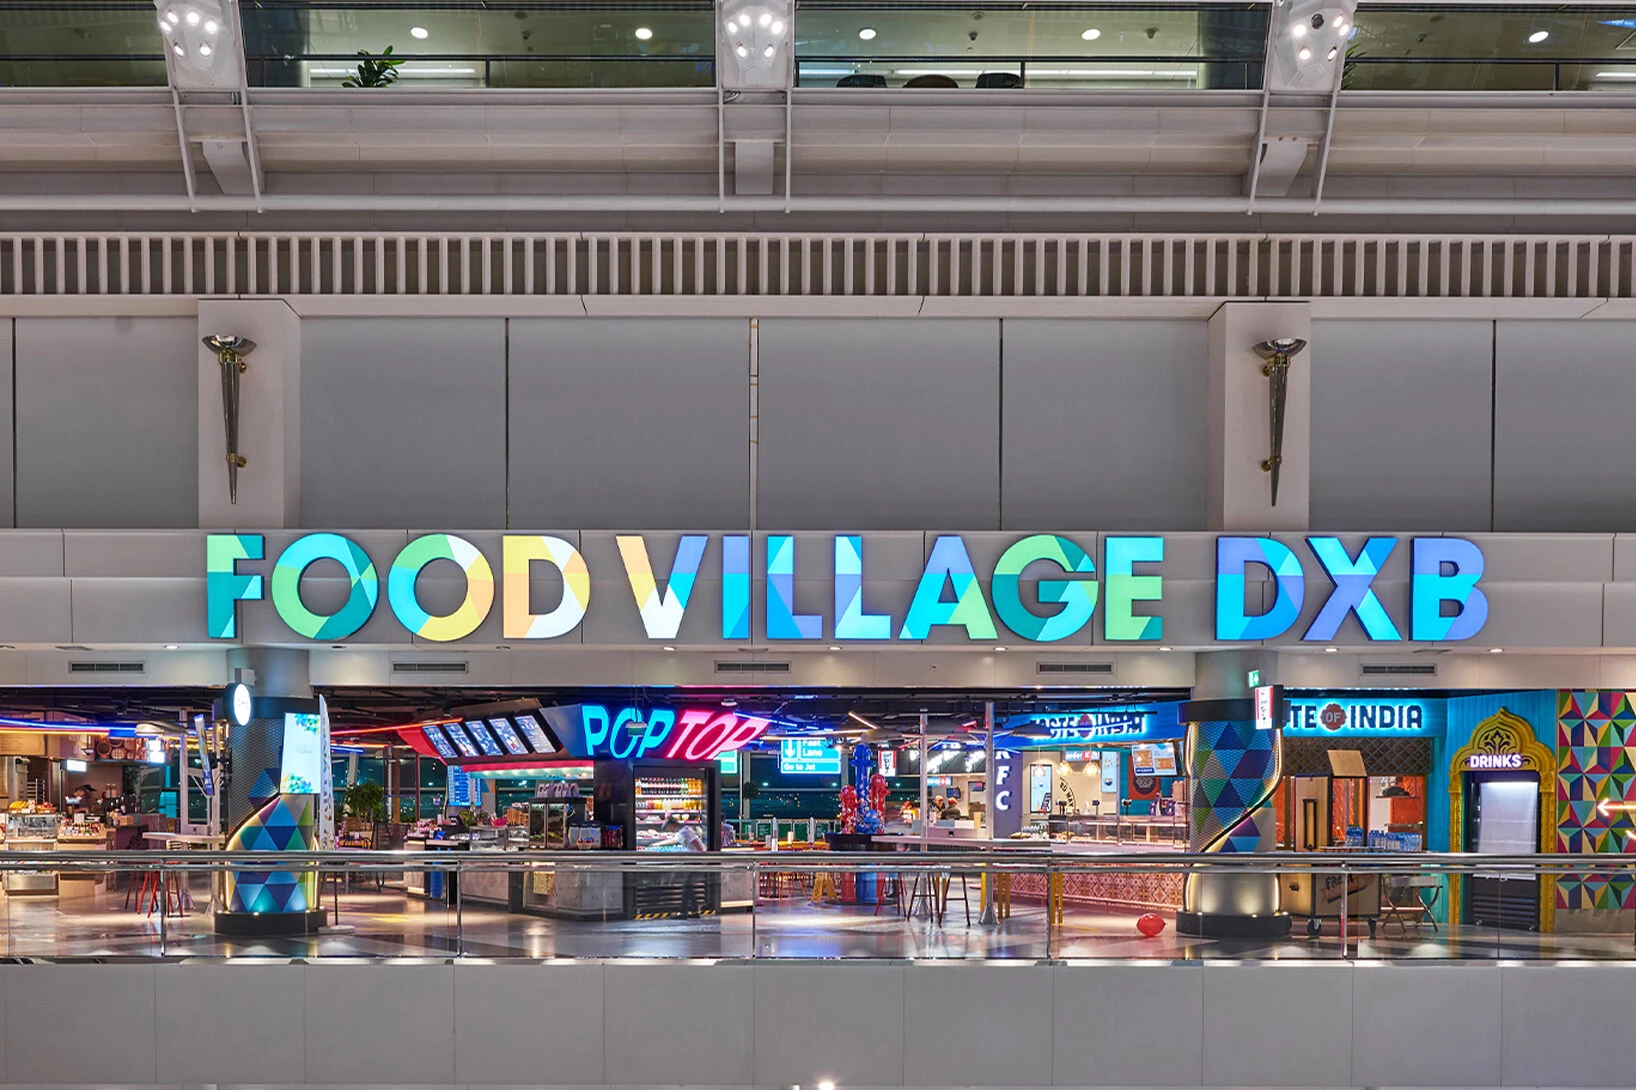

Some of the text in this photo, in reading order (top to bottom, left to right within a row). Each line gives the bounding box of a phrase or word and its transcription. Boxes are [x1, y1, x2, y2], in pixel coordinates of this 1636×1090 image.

[206, 532, 1489, 643] FOOD VILLAGE DXB
[581, 704, 676, 759] POP
[667, 710, 770, 761] TOP
[1325, 712, 1341, 723] OF
[1350, 705, 1422, 729] INDIA
[1470, 754, 1522, 768] DRINKS
